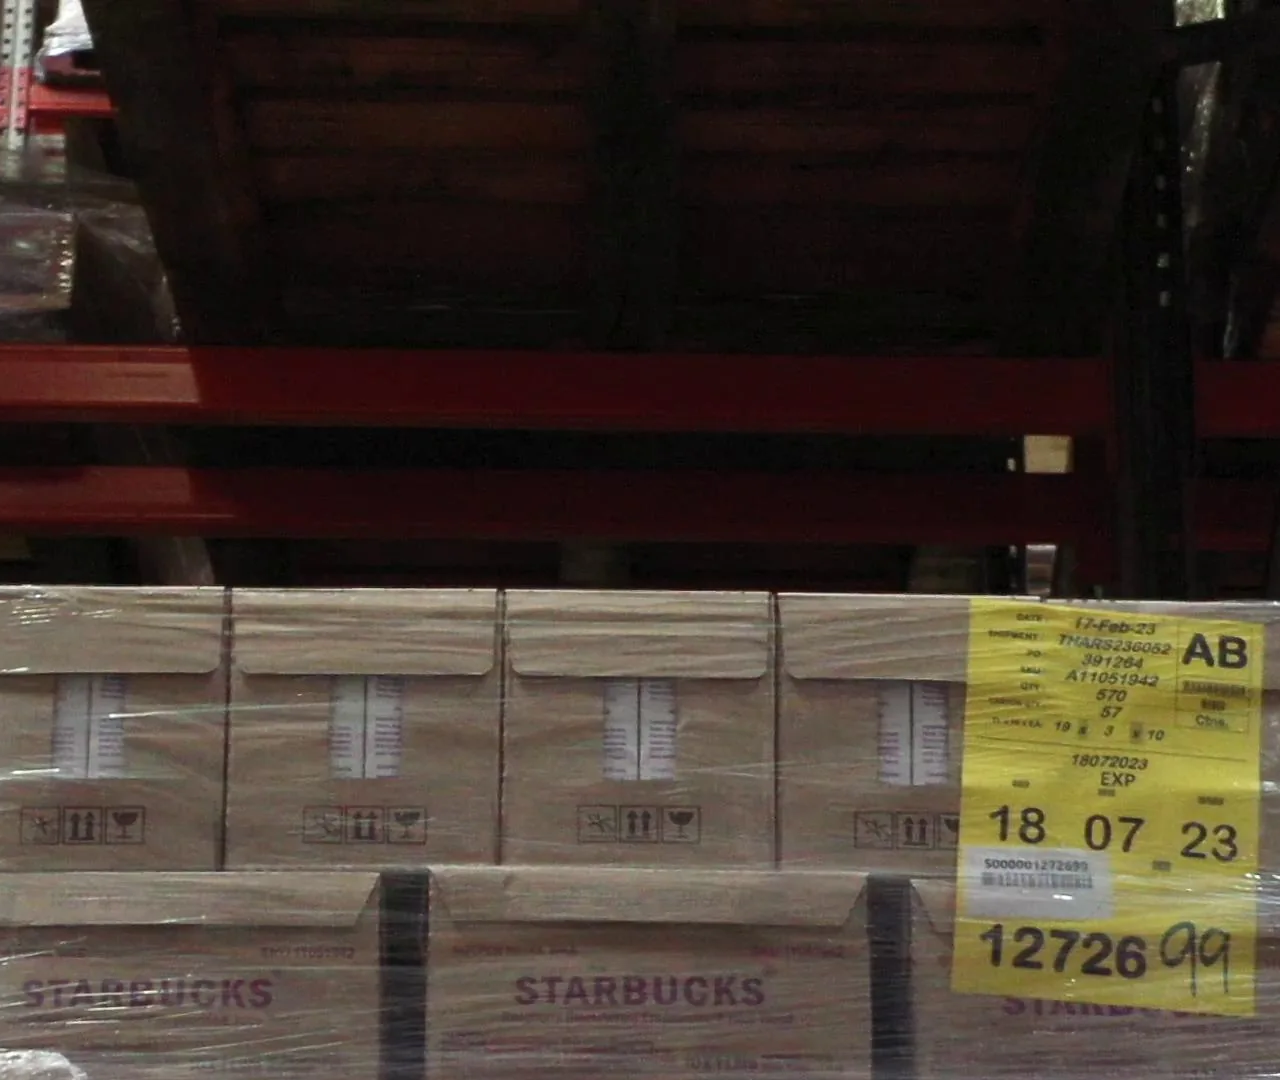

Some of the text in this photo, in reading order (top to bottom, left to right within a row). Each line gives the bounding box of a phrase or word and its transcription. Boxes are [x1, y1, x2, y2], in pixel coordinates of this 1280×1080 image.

[1074, 618, 1157, 636] 17-Feb-23
[1182, 632, 1249, 670] AB
[1095, 688, 1128, 703] 570
[1099, 706, 1123, 719] 57
[1071, 752, 1149, 772] 18072023
[1099, 771, 1136, 788] EXP
[988, 804, 1239, 862] 18 07 23
[979, 923, 1148, 979] 12726
[24, 978, 275, 1008] STARBUCKS
[515, 976, 766, 1006] STARBUCKS
